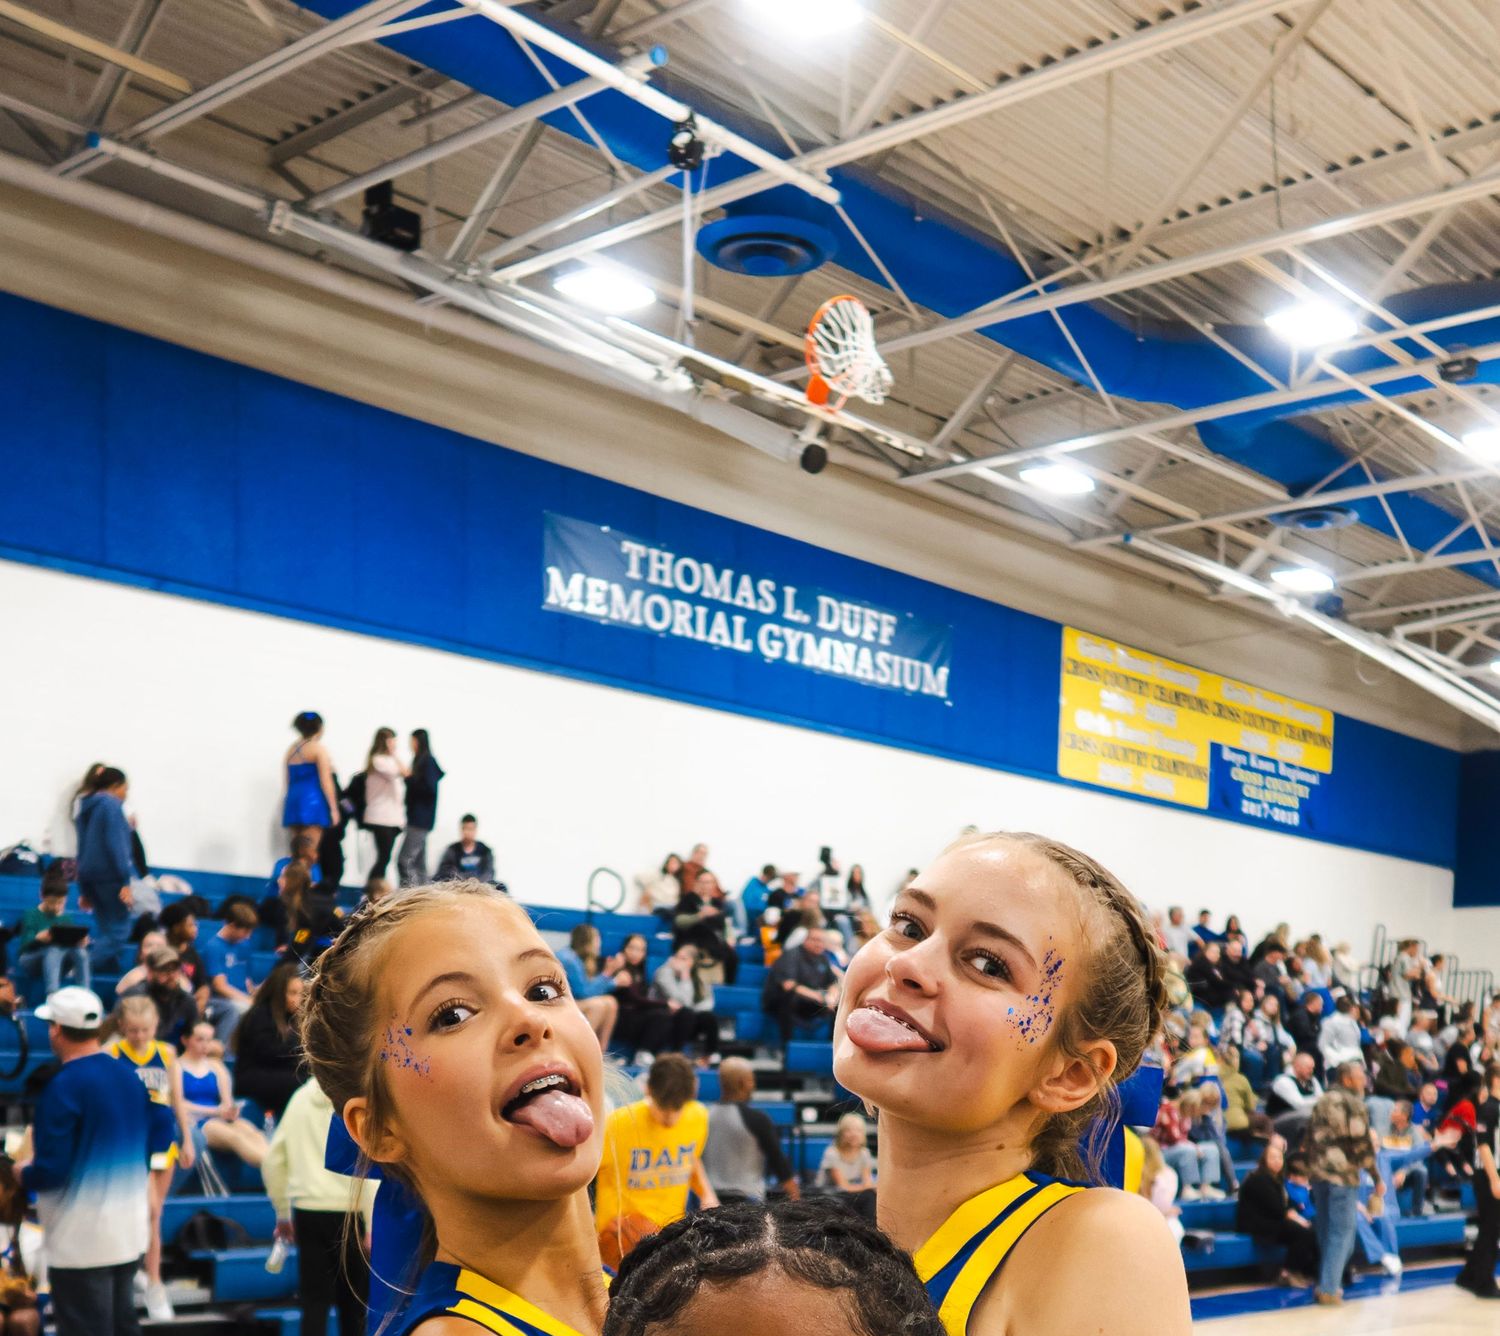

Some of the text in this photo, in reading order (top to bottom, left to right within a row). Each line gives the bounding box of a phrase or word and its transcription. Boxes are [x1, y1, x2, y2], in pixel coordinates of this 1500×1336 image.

[546, 566, 950, 699] MEMORIAL GYMNASIUM
[620, 540, 898, 646] THOMAS L. DUFF
